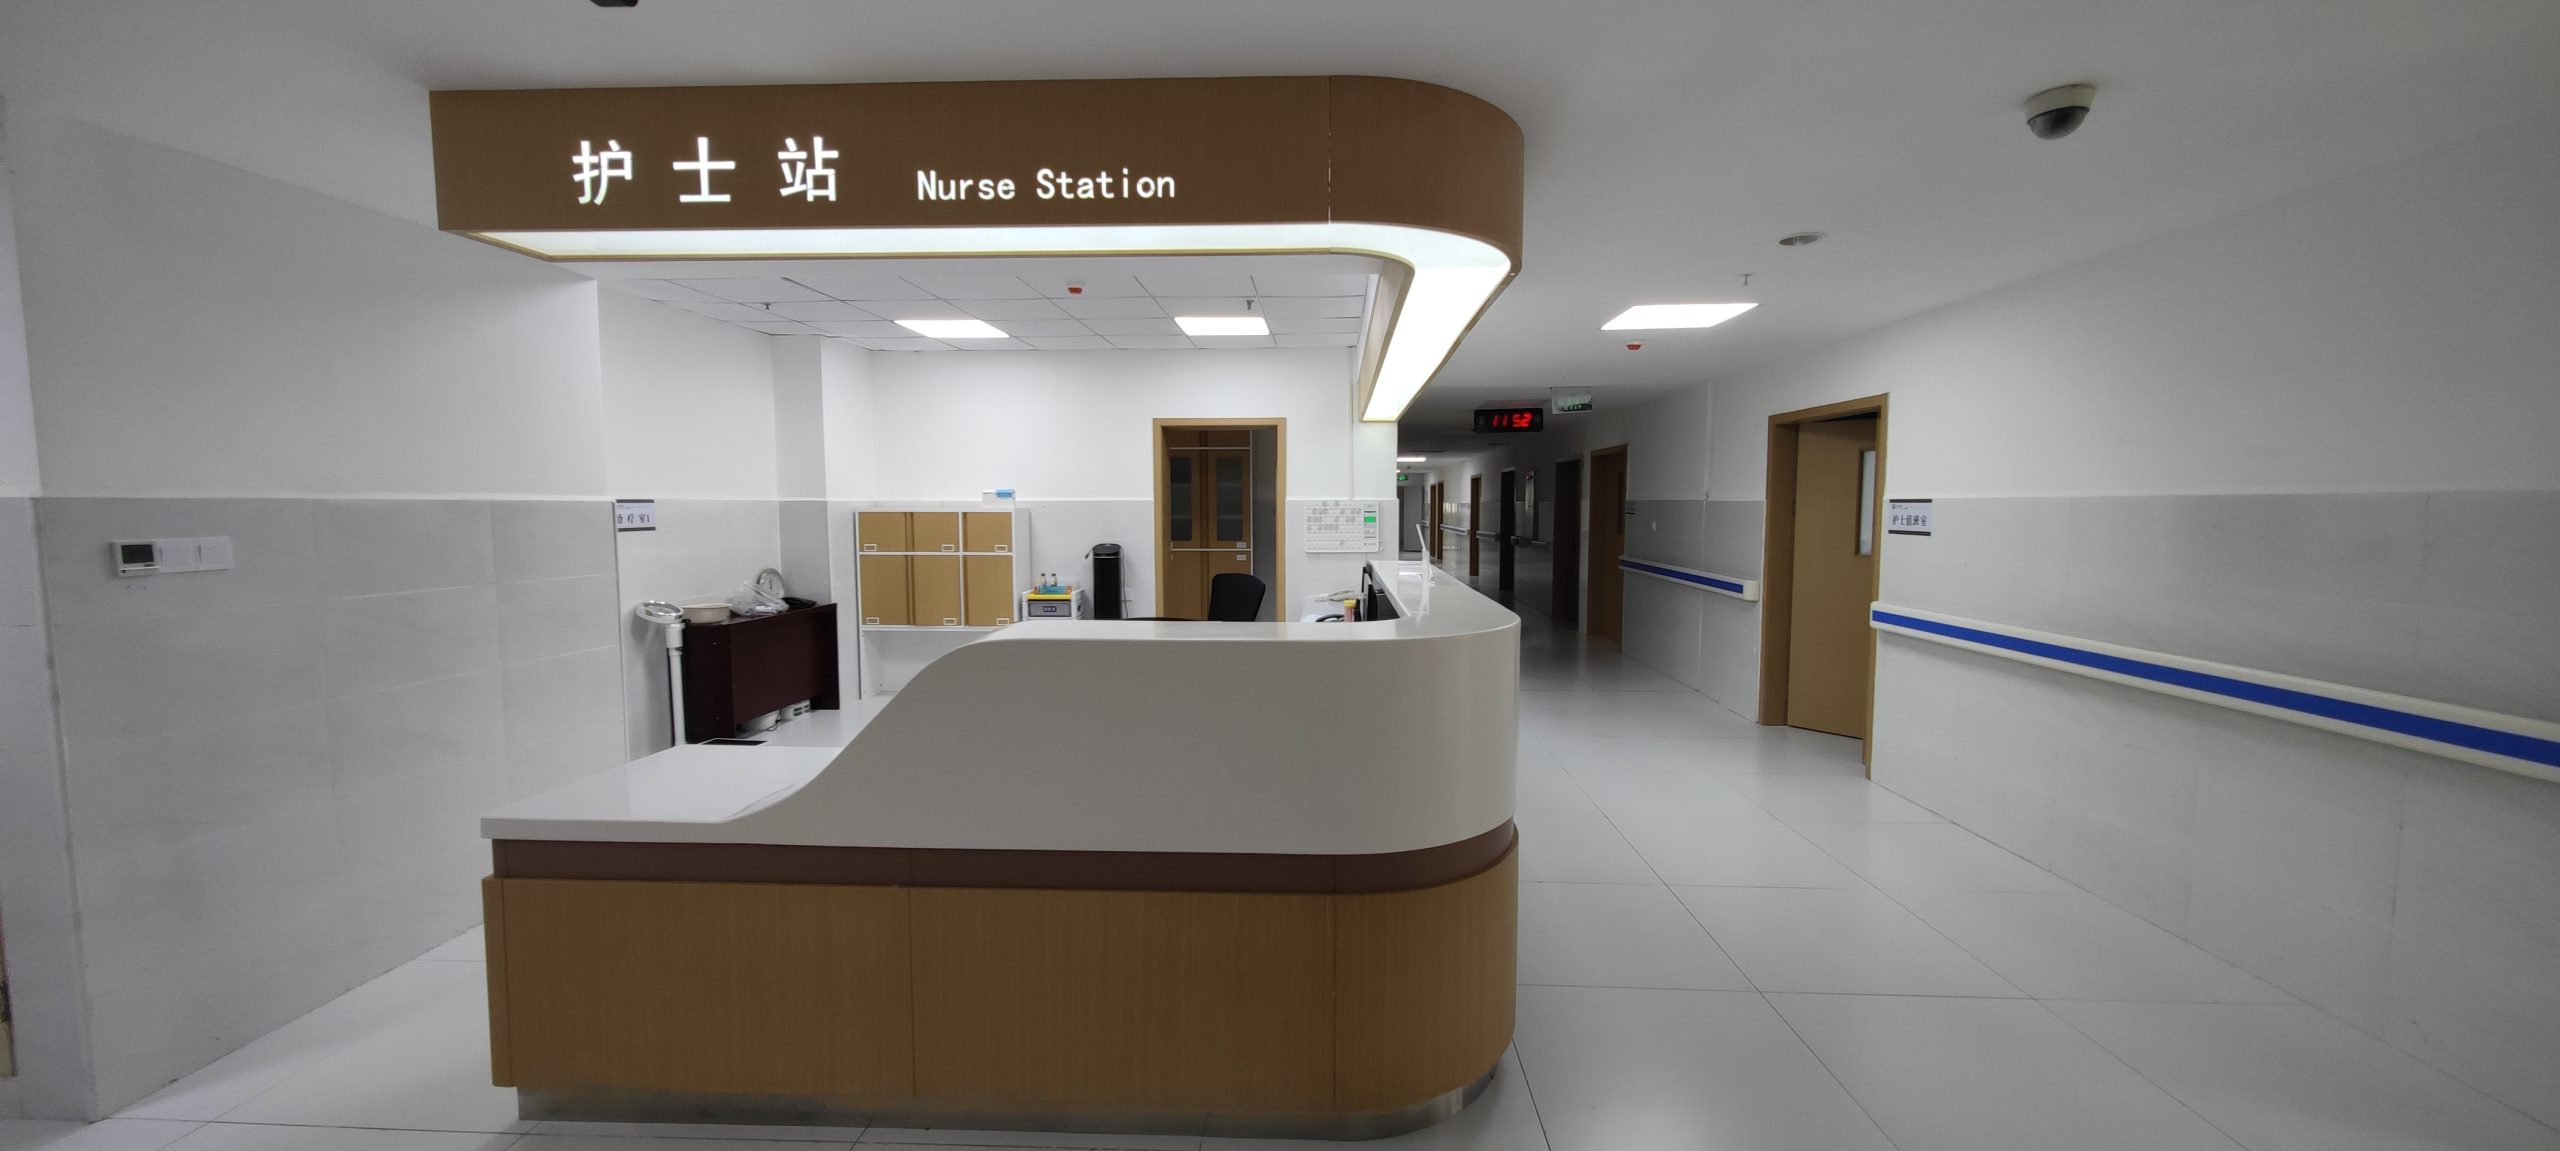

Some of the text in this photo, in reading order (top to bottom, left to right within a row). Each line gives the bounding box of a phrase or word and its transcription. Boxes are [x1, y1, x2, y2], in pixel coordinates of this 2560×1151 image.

[572, 136, 839, 206] 护士站
[917, 168, 1175, 201] Nurse Station
